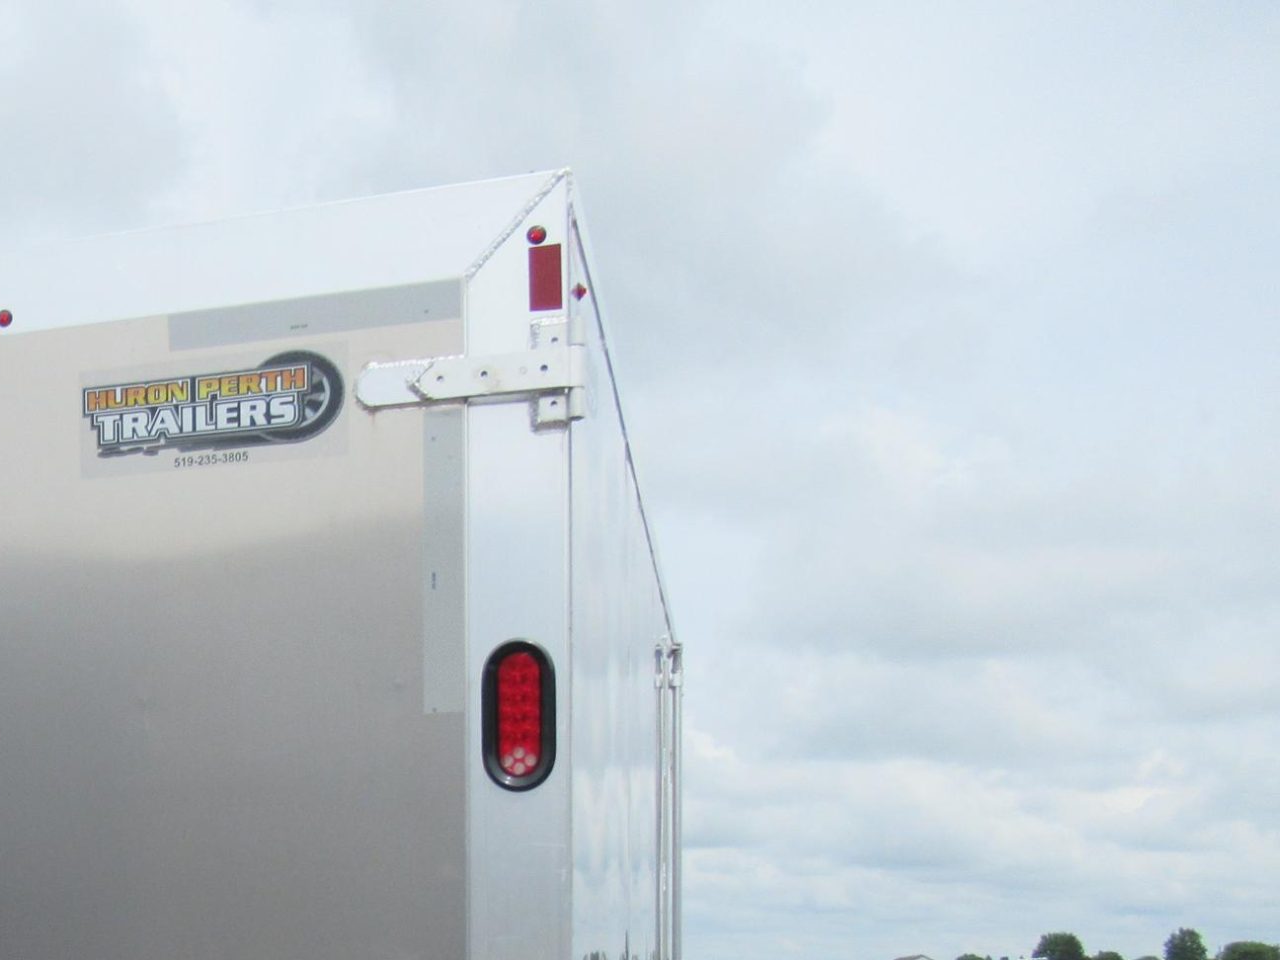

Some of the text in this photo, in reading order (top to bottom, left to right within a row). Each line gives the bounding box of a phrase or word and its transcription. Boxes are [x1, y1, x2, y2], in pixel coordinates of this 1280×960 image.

[86, 366, 307, 412] HURON PERTH
[96, 394, 295, 443] TRAILERS
[173, 451, 249, 468] 519-235-3805
